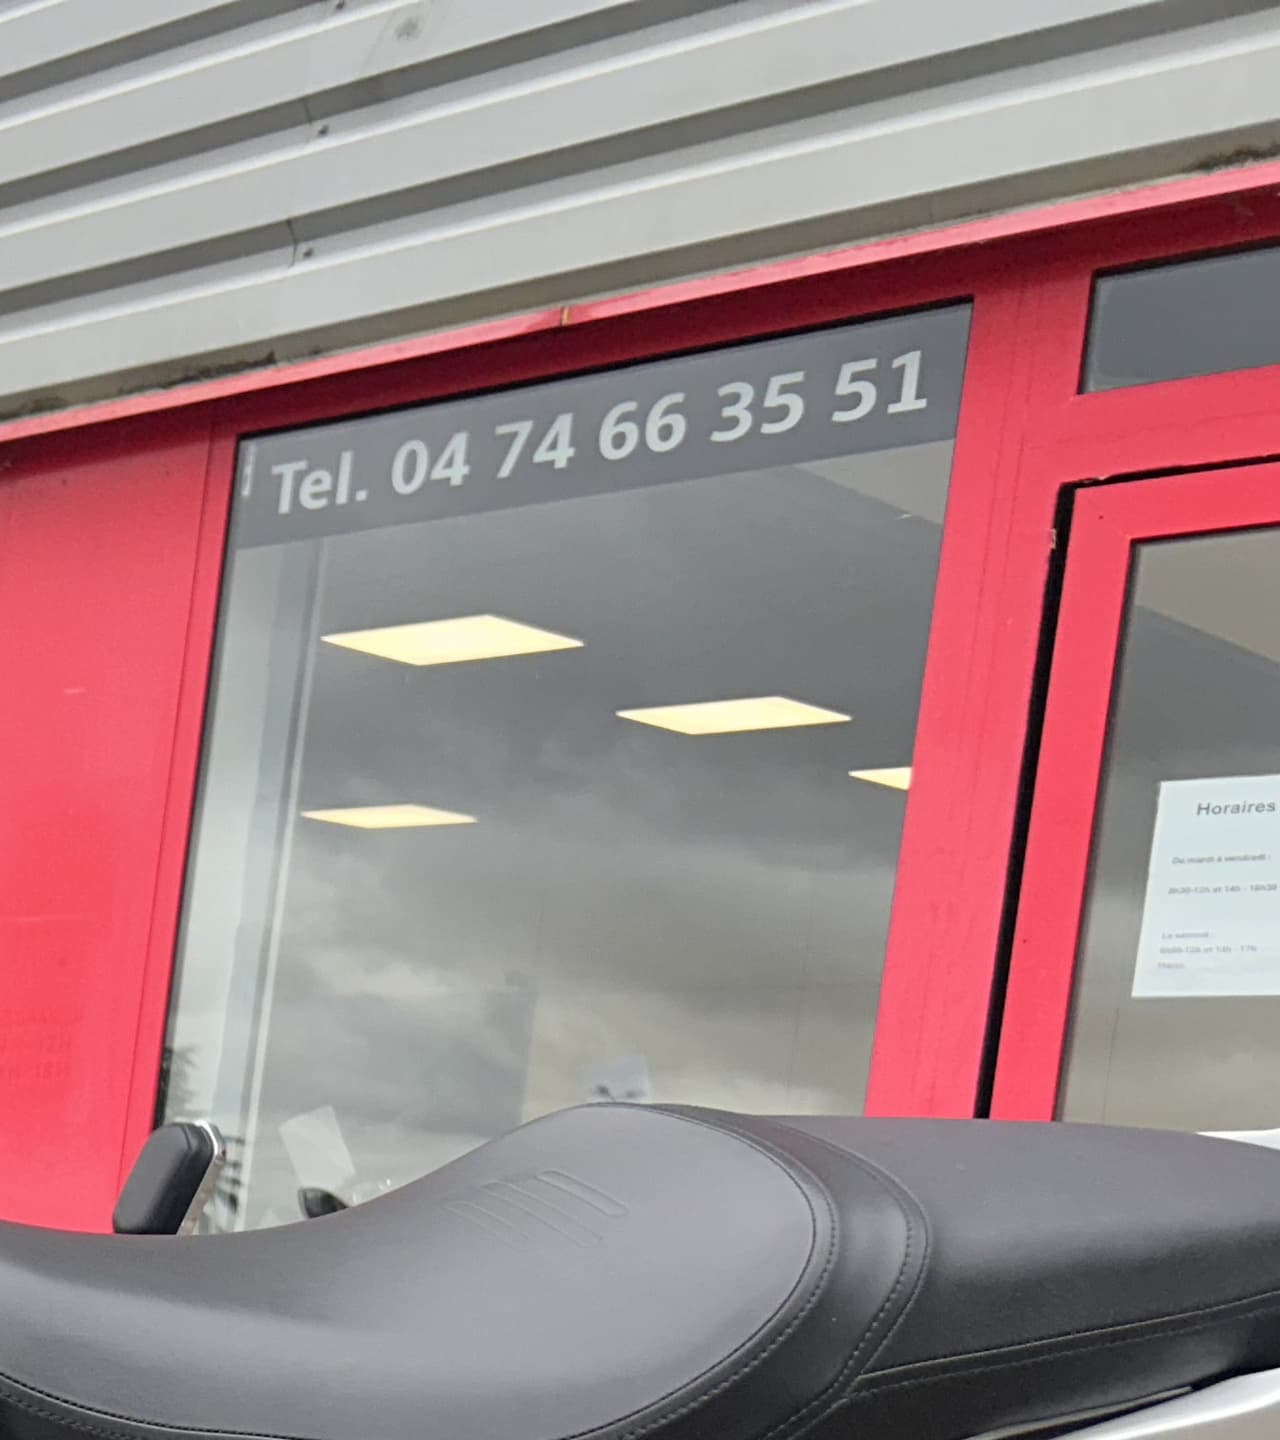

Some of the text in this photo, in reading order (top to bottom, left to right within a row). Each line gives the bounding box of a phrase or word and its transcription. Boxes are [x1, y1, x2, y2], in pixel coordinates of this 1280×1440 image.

[272, 351, 928, 514] Tel. 04 74 66 35 51
[1196, 800, 1276, 817] Horaires
